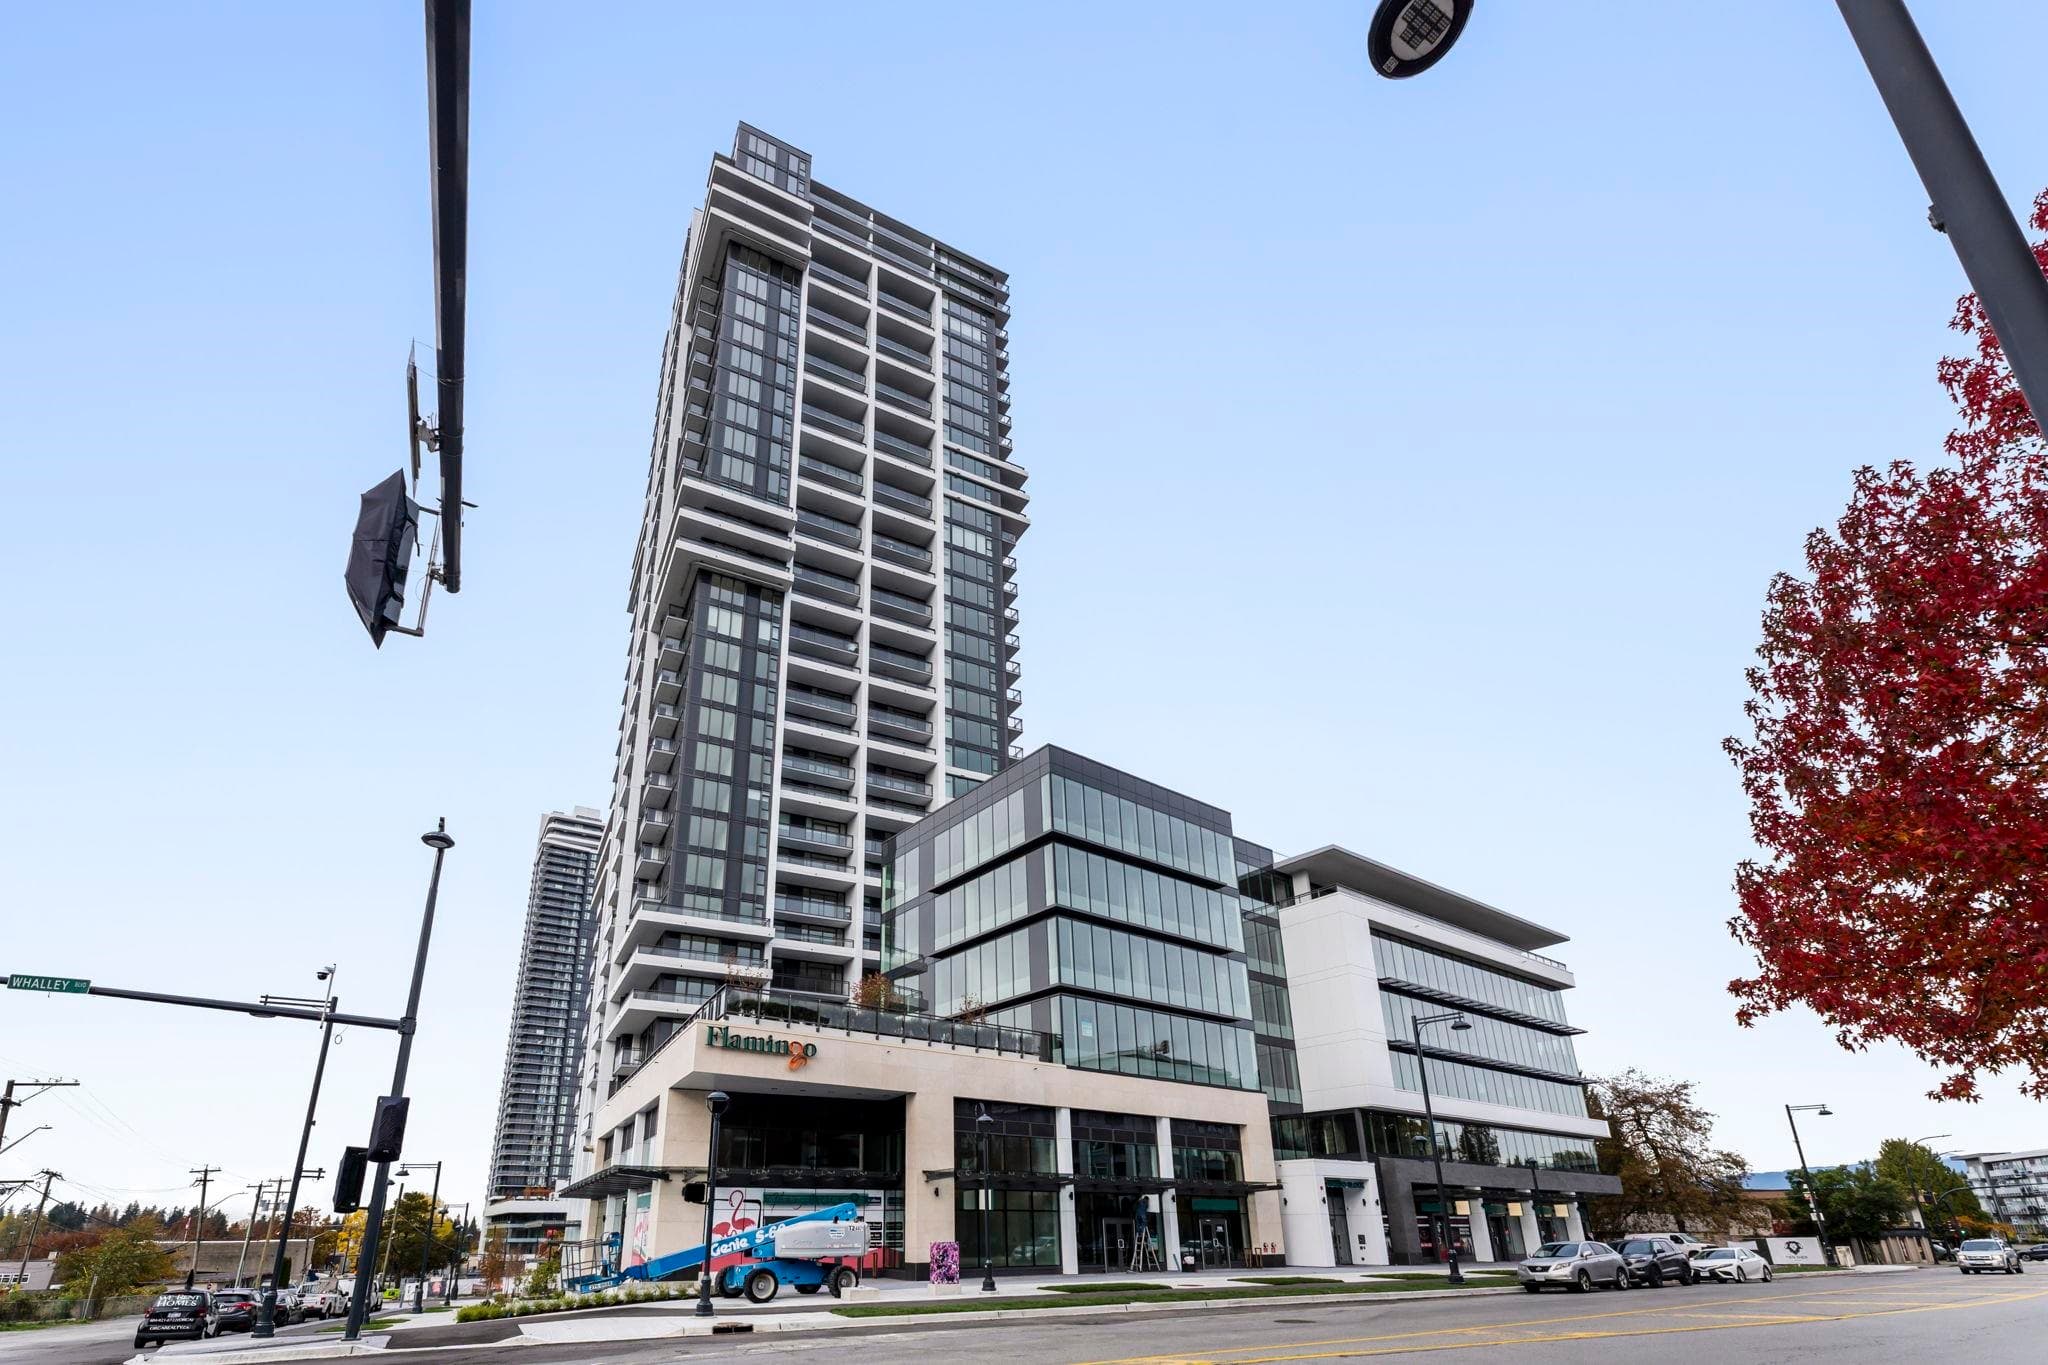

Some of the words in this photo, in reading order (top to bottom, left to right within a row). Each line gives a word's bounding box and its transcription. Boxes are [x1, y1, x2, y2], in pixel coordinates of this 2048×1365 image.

[12, 977, 71, 990] WHALLEY
[706, 1026, 817, 1071] Flamingo
[711, 1237, 749, 1257] Genie
